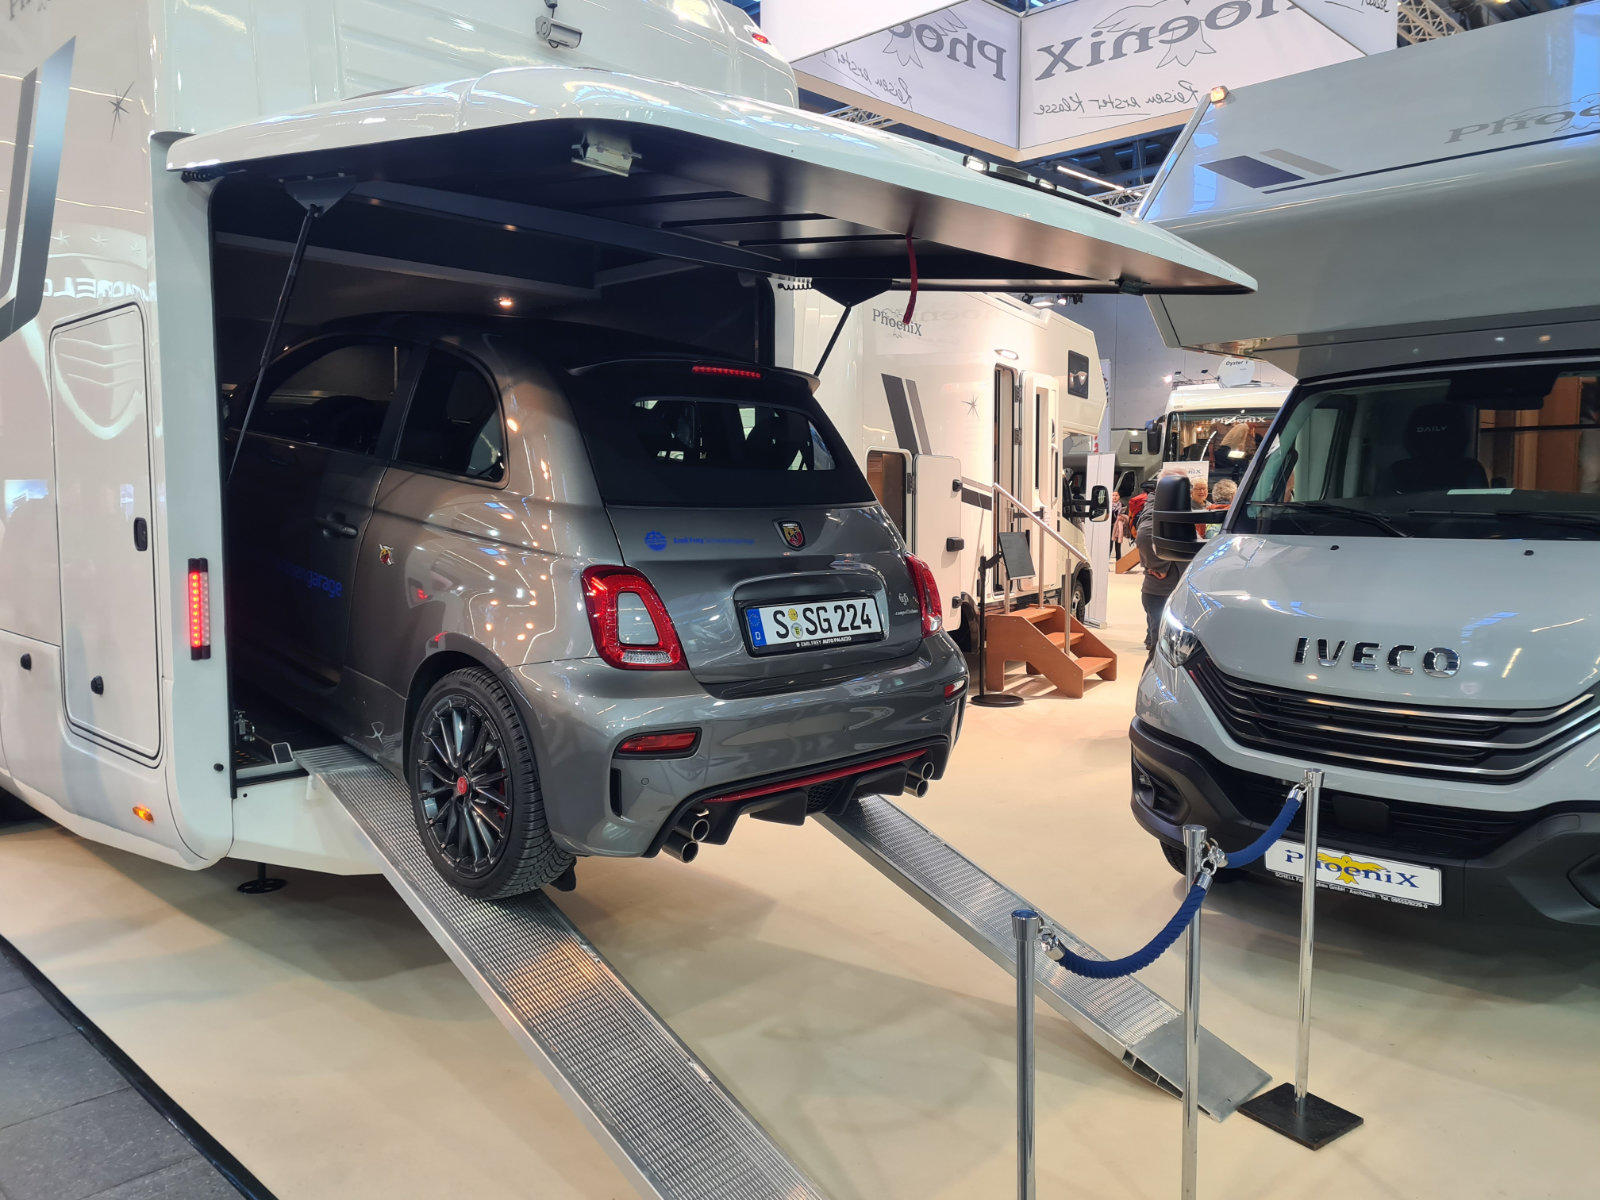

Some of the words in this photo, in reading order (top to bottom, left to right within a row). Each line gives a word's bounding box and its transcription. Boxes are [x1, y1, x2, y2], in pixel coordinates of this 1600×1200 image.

[1416, 425, 1448, 433] DAILY
[773, 610, 789, 639] S
[802, 606, 833, 635] SG
[834, 602, 872, 632] 224
[1294, 636, 1461, 678] IVECO
